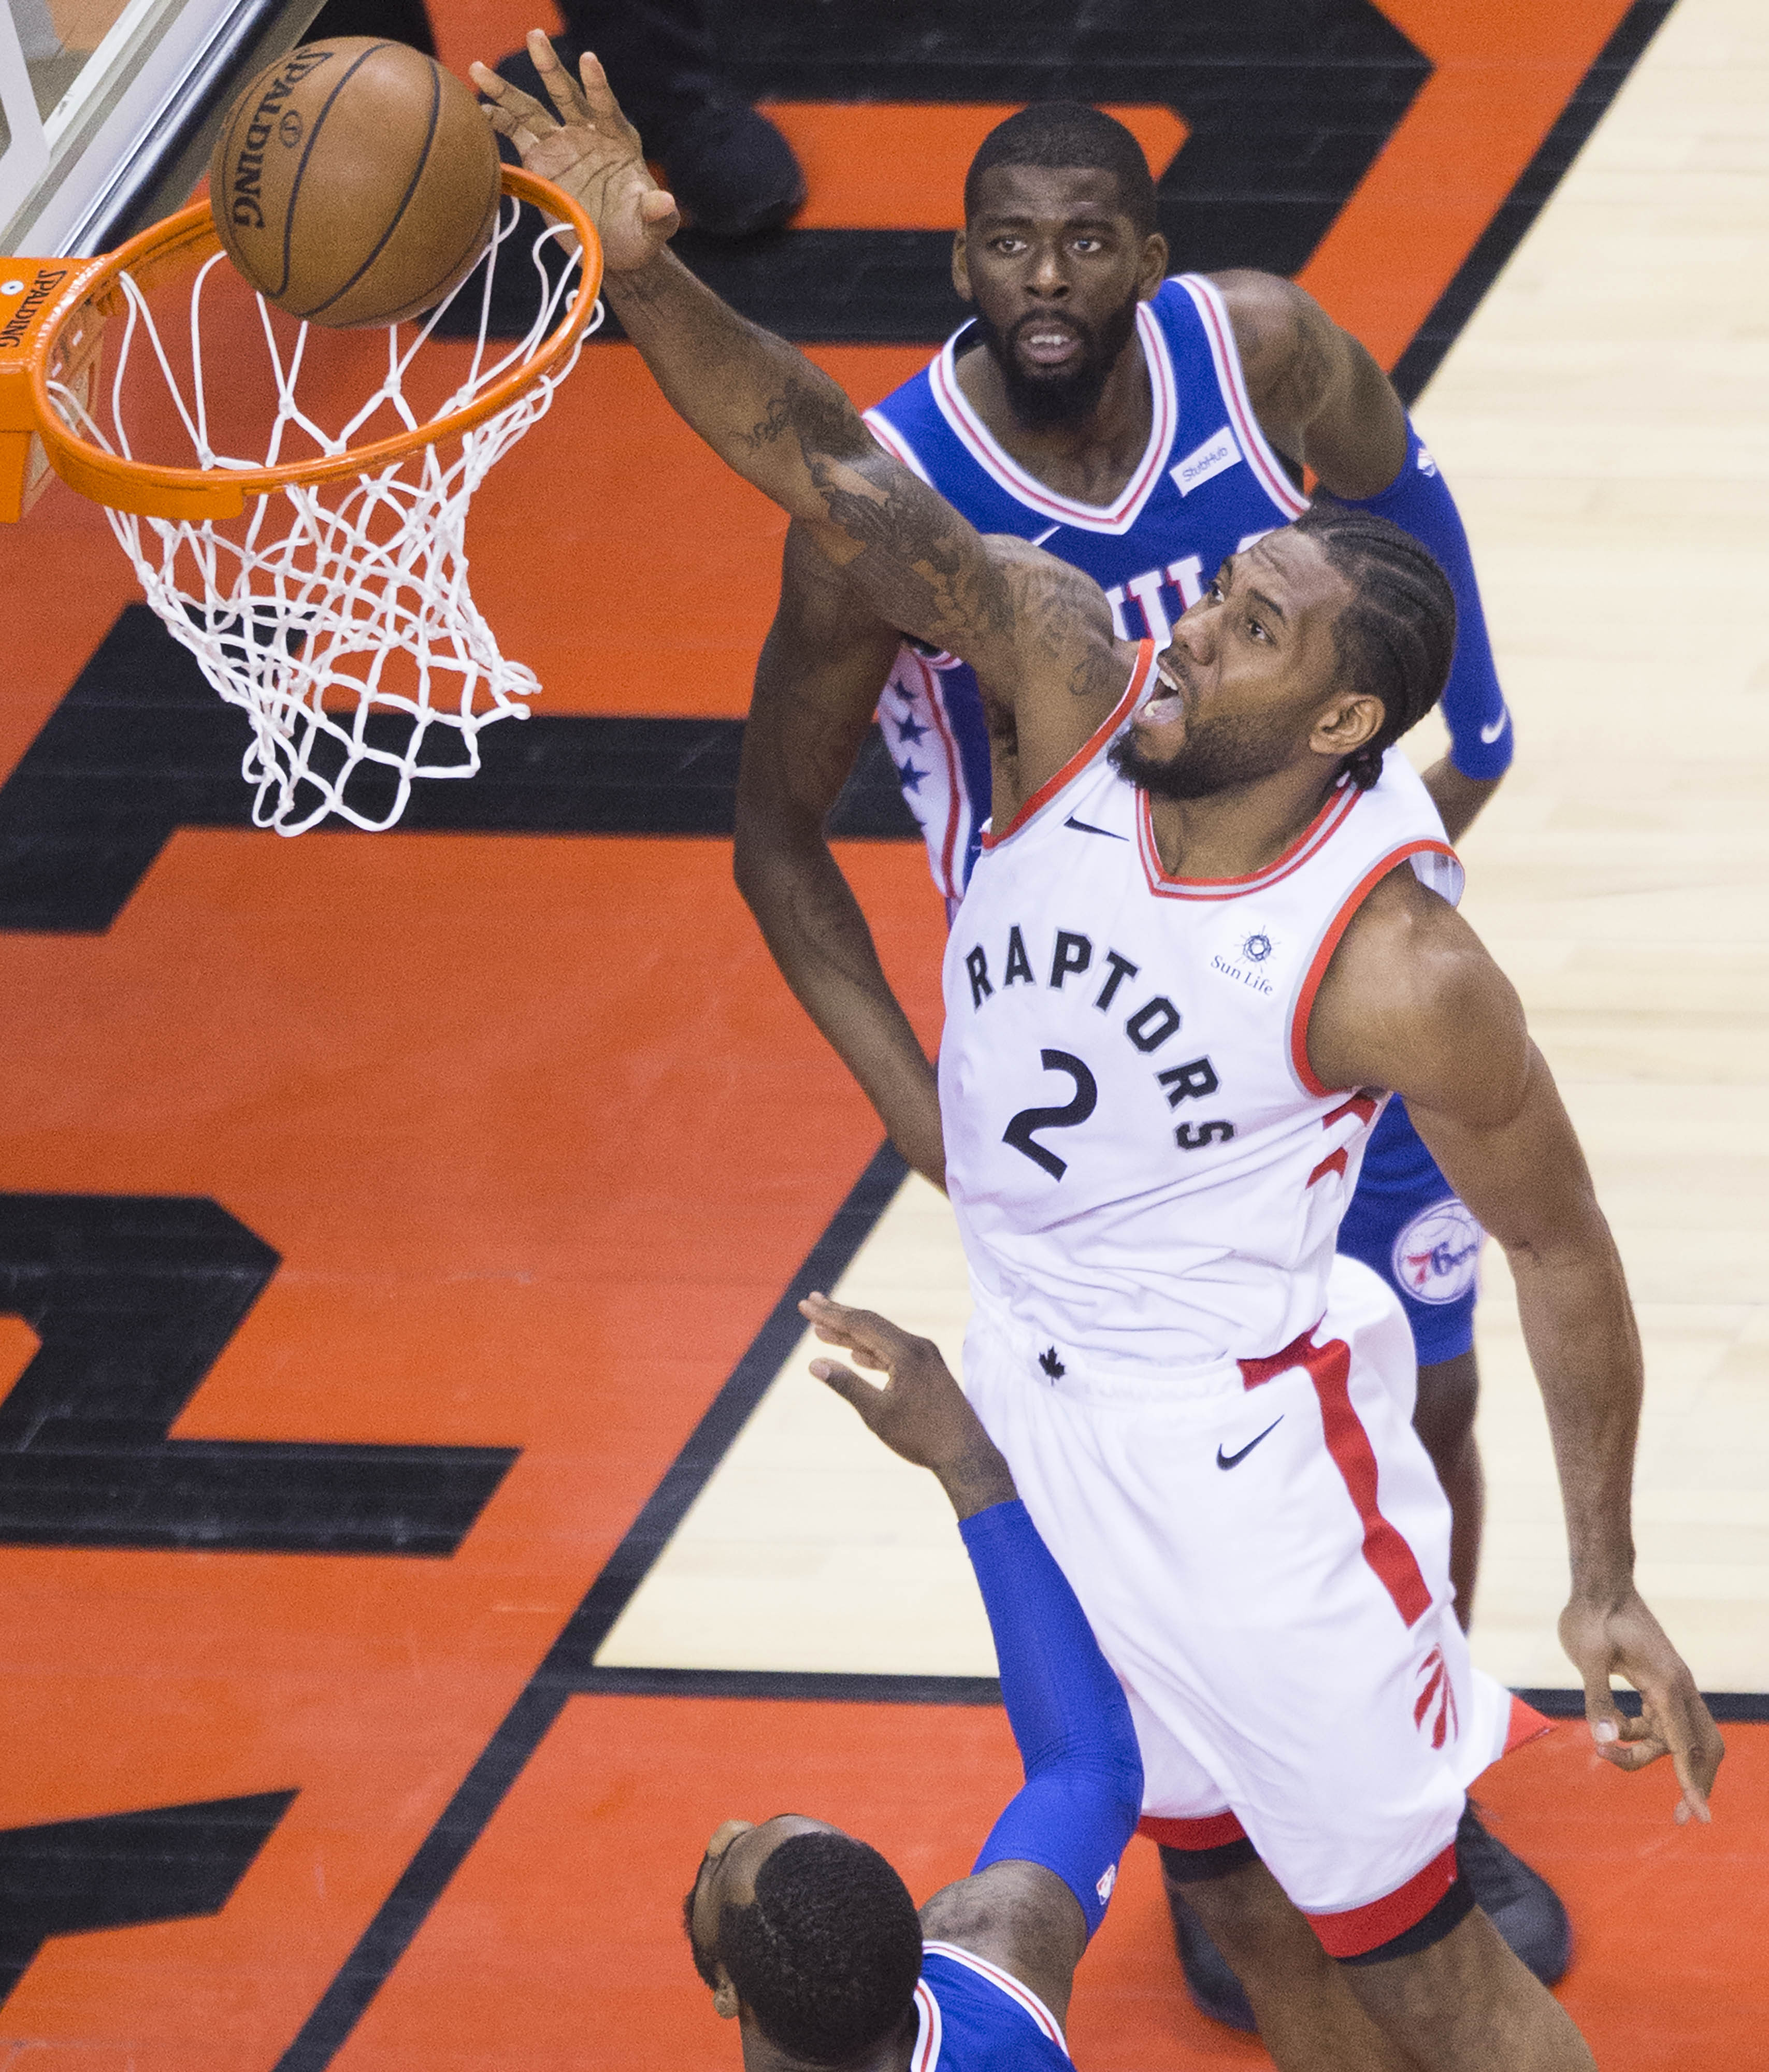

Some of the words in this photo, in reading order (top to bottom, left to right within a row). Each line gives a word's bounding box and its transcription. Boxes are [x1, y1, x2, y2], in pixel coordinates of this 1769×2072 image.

[233, 50, 334, 229] SPALDING
[0, 270, 67, 347] SPALDING
[1183, 447, 1228, 482] StubHub
[1211, 955, 1241, 980] Sun
[1244, 972, 1273, 996] Life
[966, 924, 1237, 1151] RAPTORS
[1002, 1049, 1097, 1183] 2
